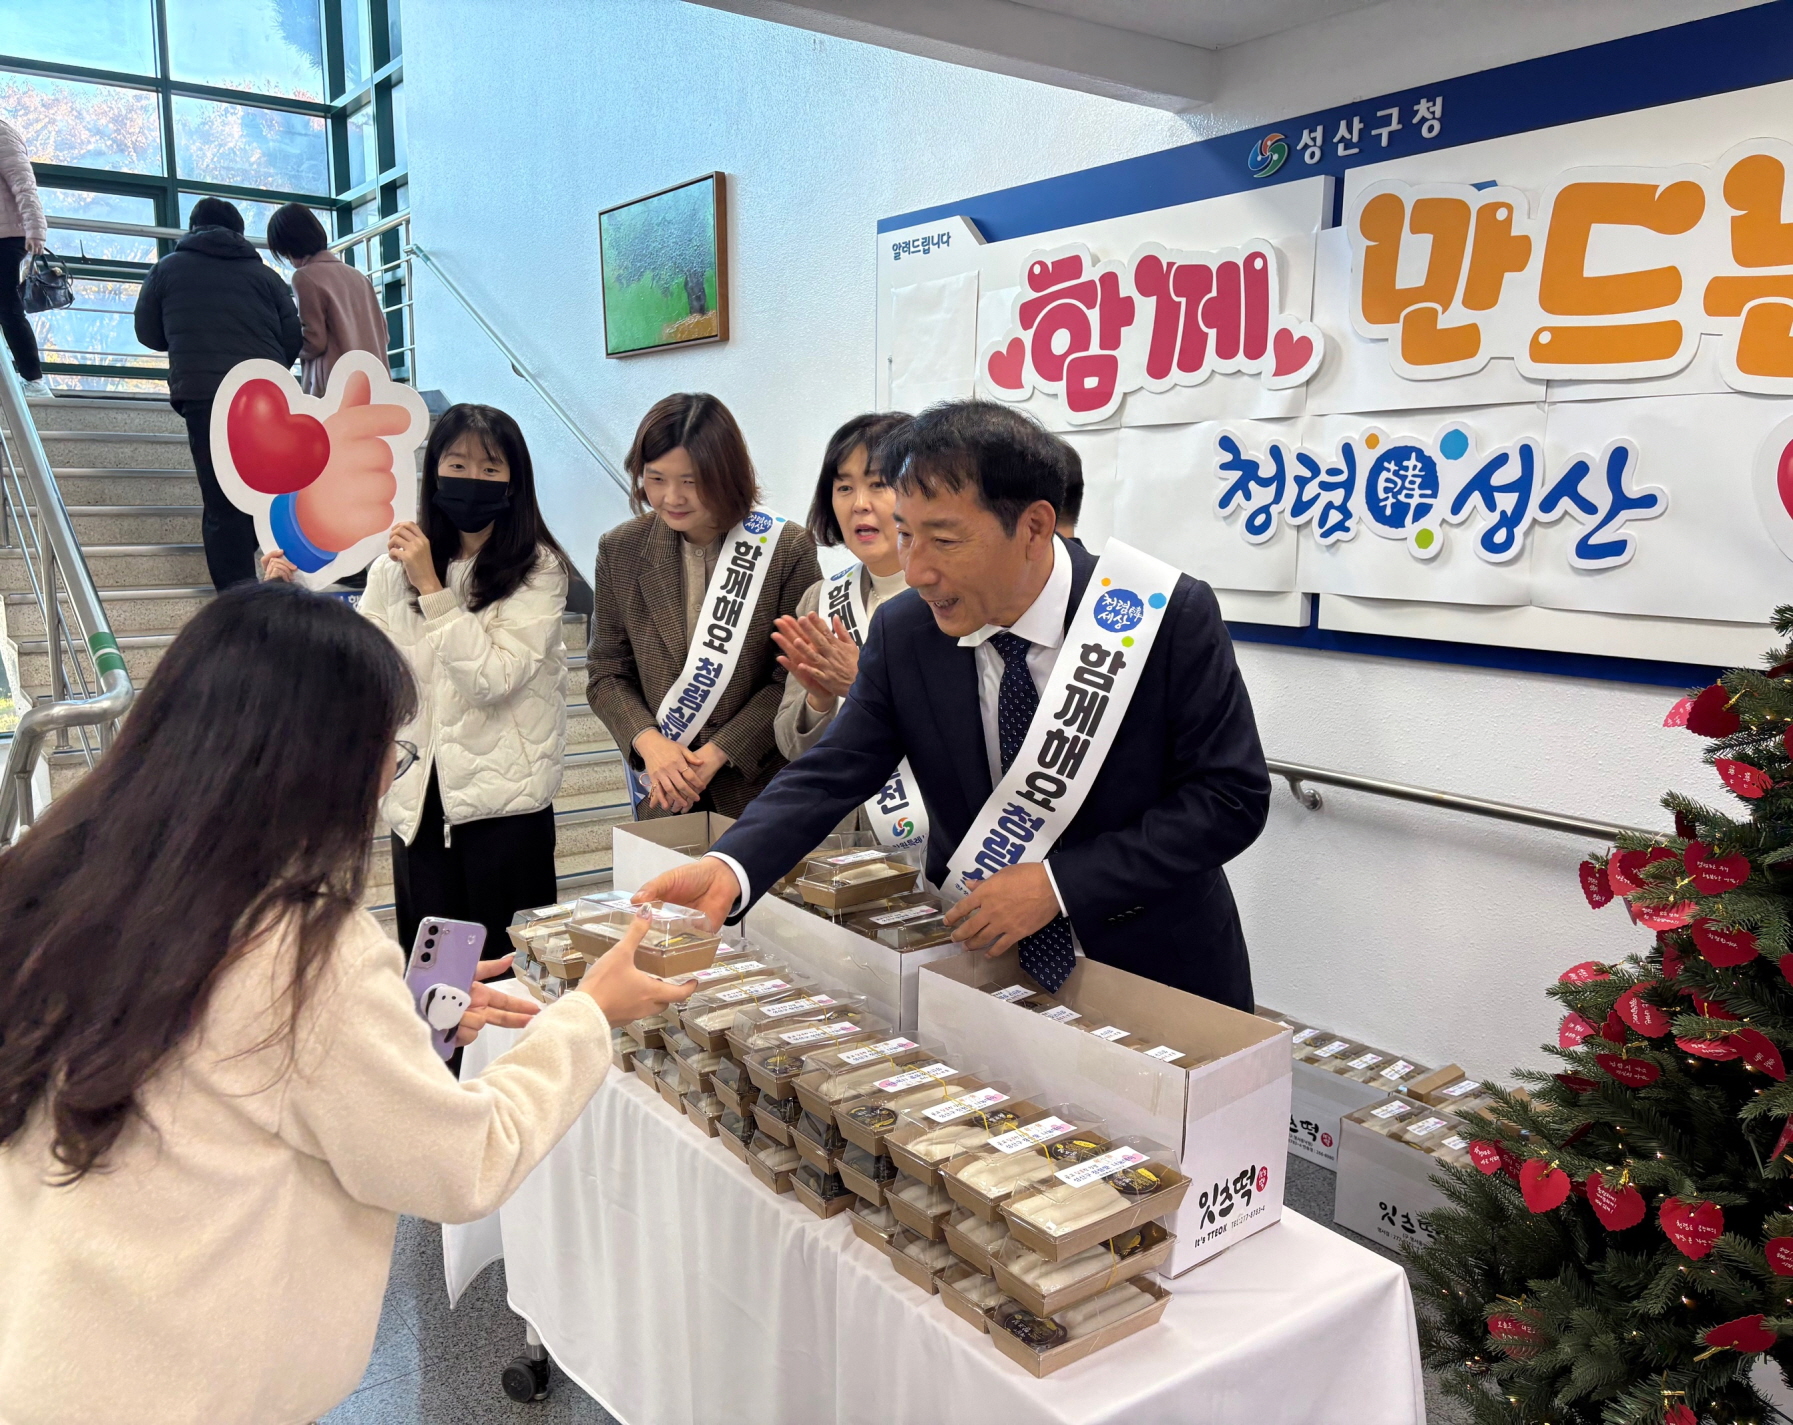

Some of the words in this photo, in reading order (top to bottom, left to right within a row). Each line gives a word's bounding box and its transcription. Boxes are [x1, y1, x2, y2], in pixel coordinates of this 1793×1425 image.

[1296, 96, 1444, 165] 성산구청
[891, 231, 952, 261] 알려드립니다
[1018, 250, 1270, 413] 함께
[702, 540, 763, 655] 함께해요
[1015, 642, 1127, 813] 함께해요
[1289, 1113, 1320, 1142] 츠떡
[1207, 1223, 1228, 1242] TTEOK
